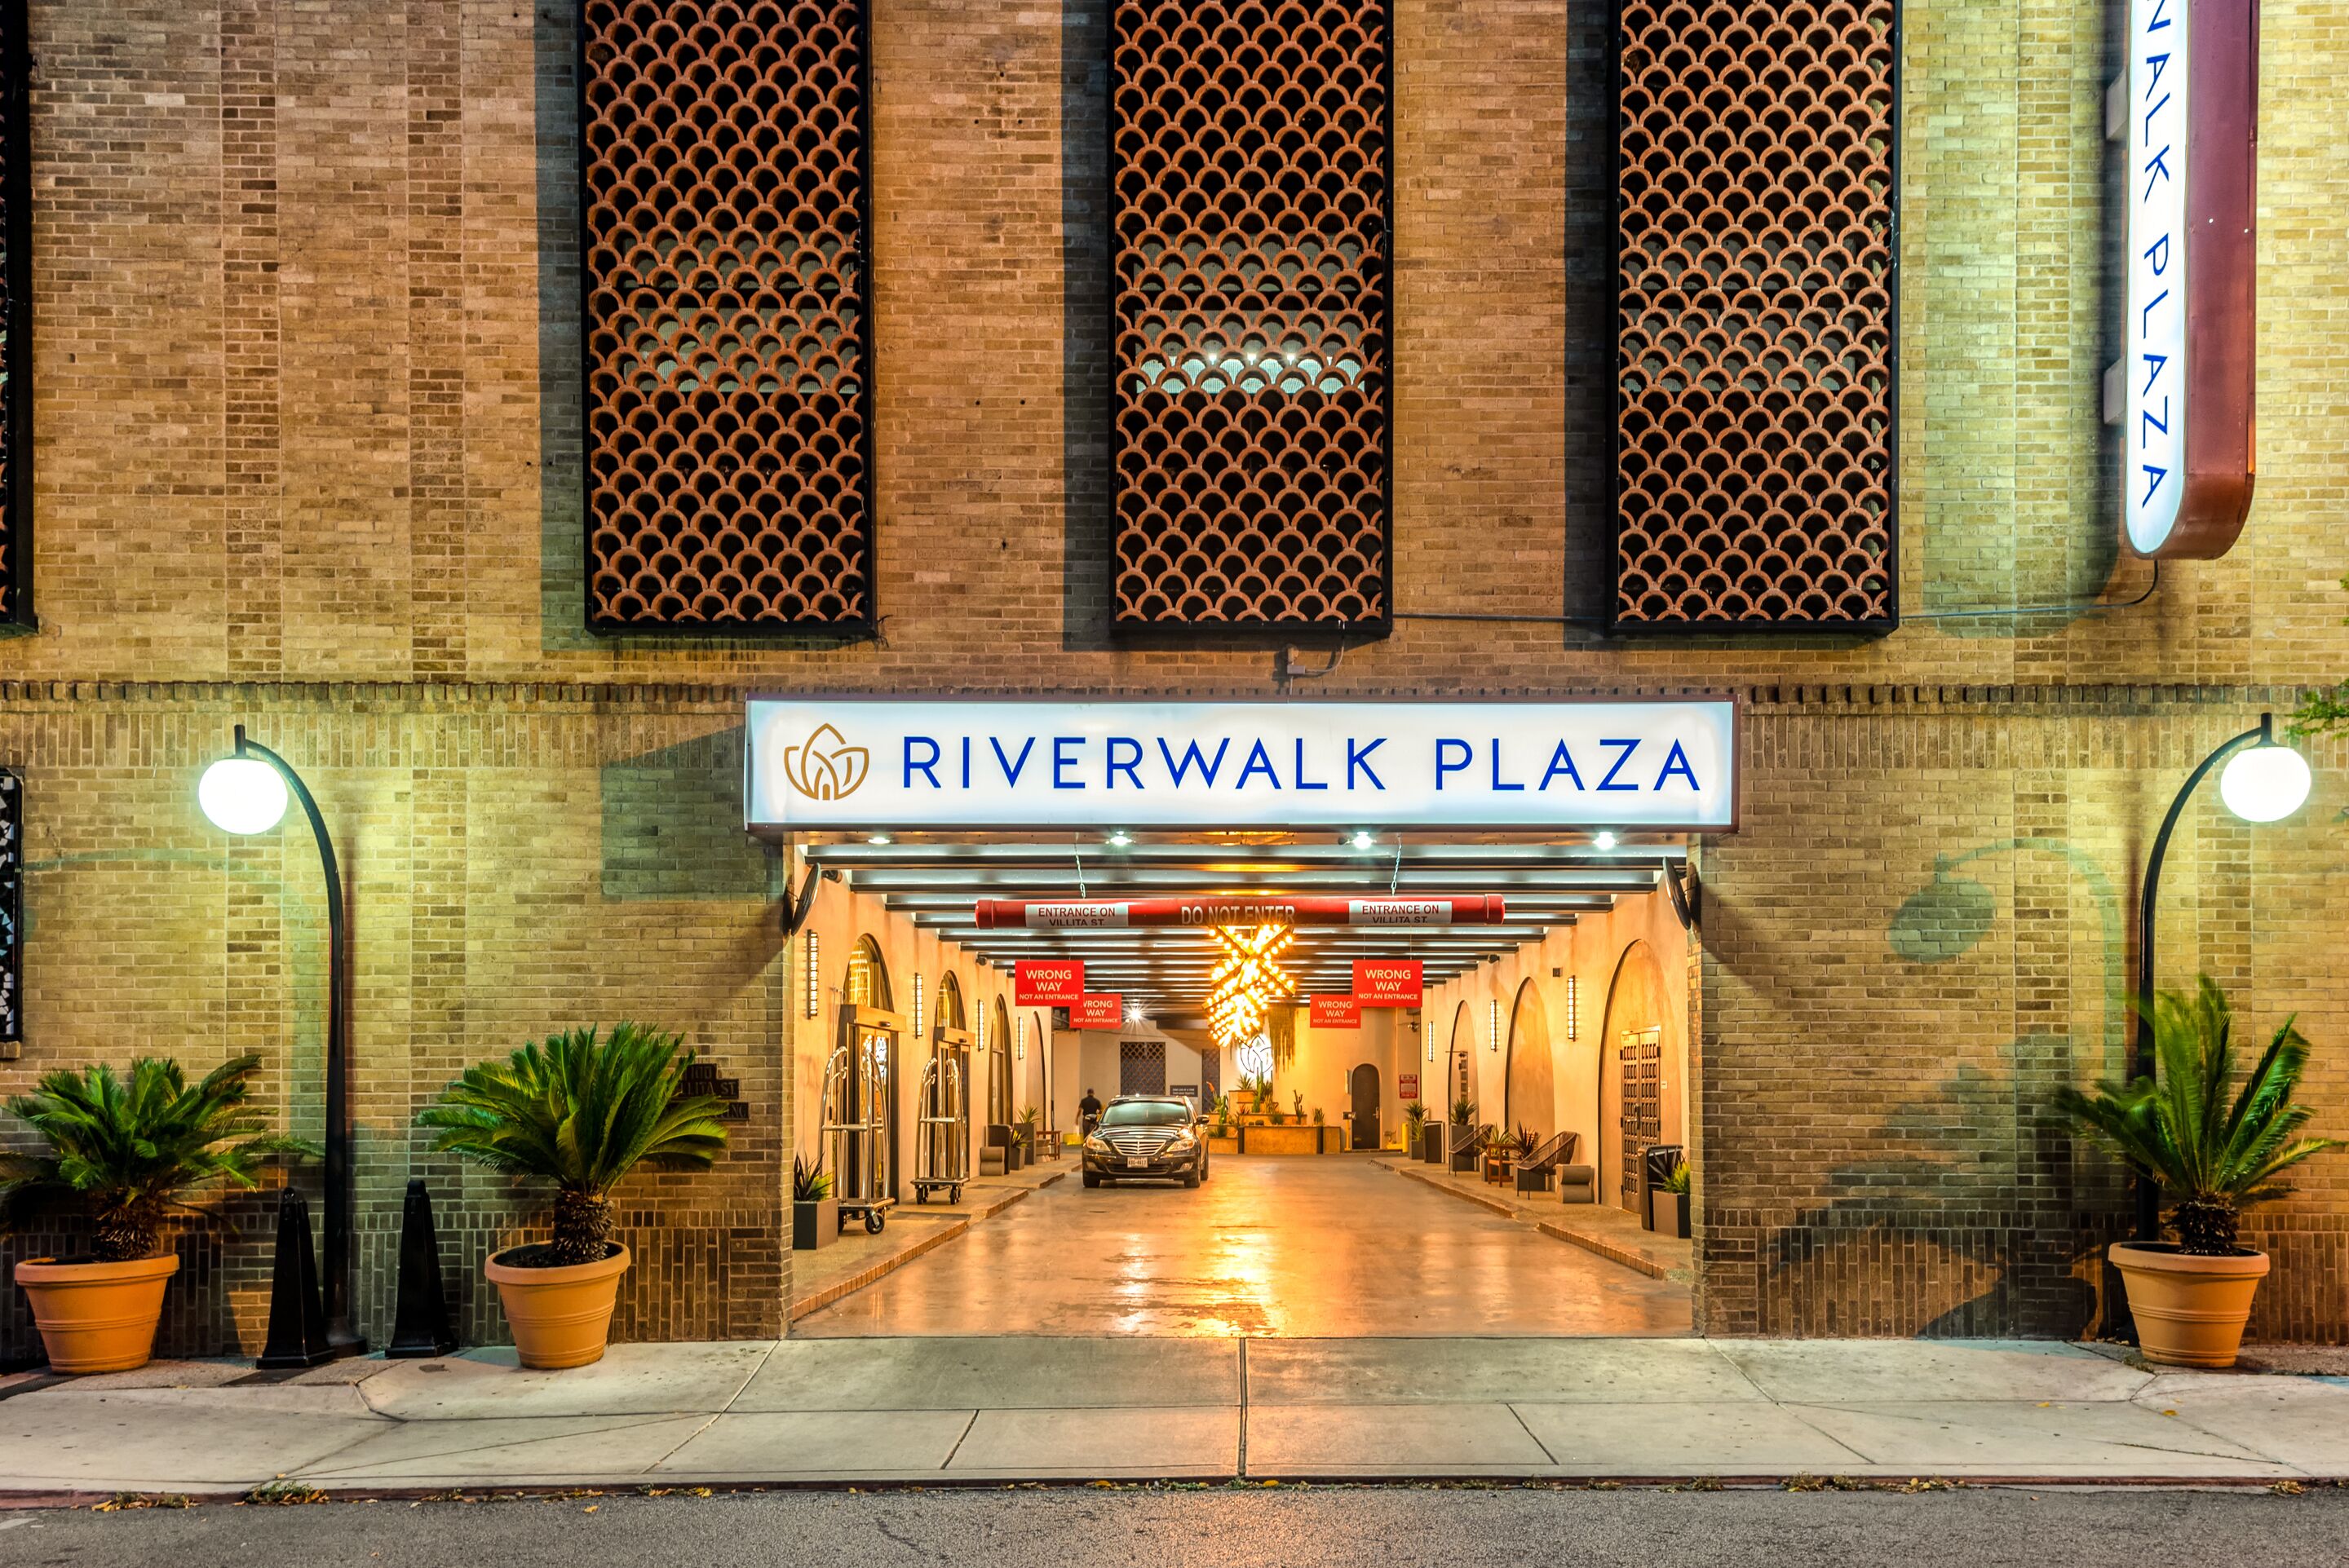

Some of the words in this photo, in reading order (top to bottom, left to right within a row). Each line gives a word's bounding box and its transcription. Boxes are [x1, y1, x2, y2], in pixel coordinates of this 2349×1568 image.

[2143, 232, 2170, 509] PLAZA
[903, 736, 1387, 790] RIVERWALK
[1436, 738, 1701, 791] PLAZA
[1038, 908, 1096, 917] ENTRANCE
[1099, 908, 1115, 917] ON
[1362, 905, 1420, 914] ENTRANCE
[1423, 905, 1439, 913] ON
[1181, 906, 1203, 924] DO
[1209, 906, 1240, 924] NOT
[1245, 905, 1295, 924] ENTER
[1026, 970, 1072, 979] WRONG
[1365, 970, 1411, 979] WRONG
[1036, 982, 1062, 992] WAY
[1375, 982, 1401, 991] WAY
[1318, 1000, 1352, 1009] WRONG
[1086, 1009, 1105, 1017] WAY
